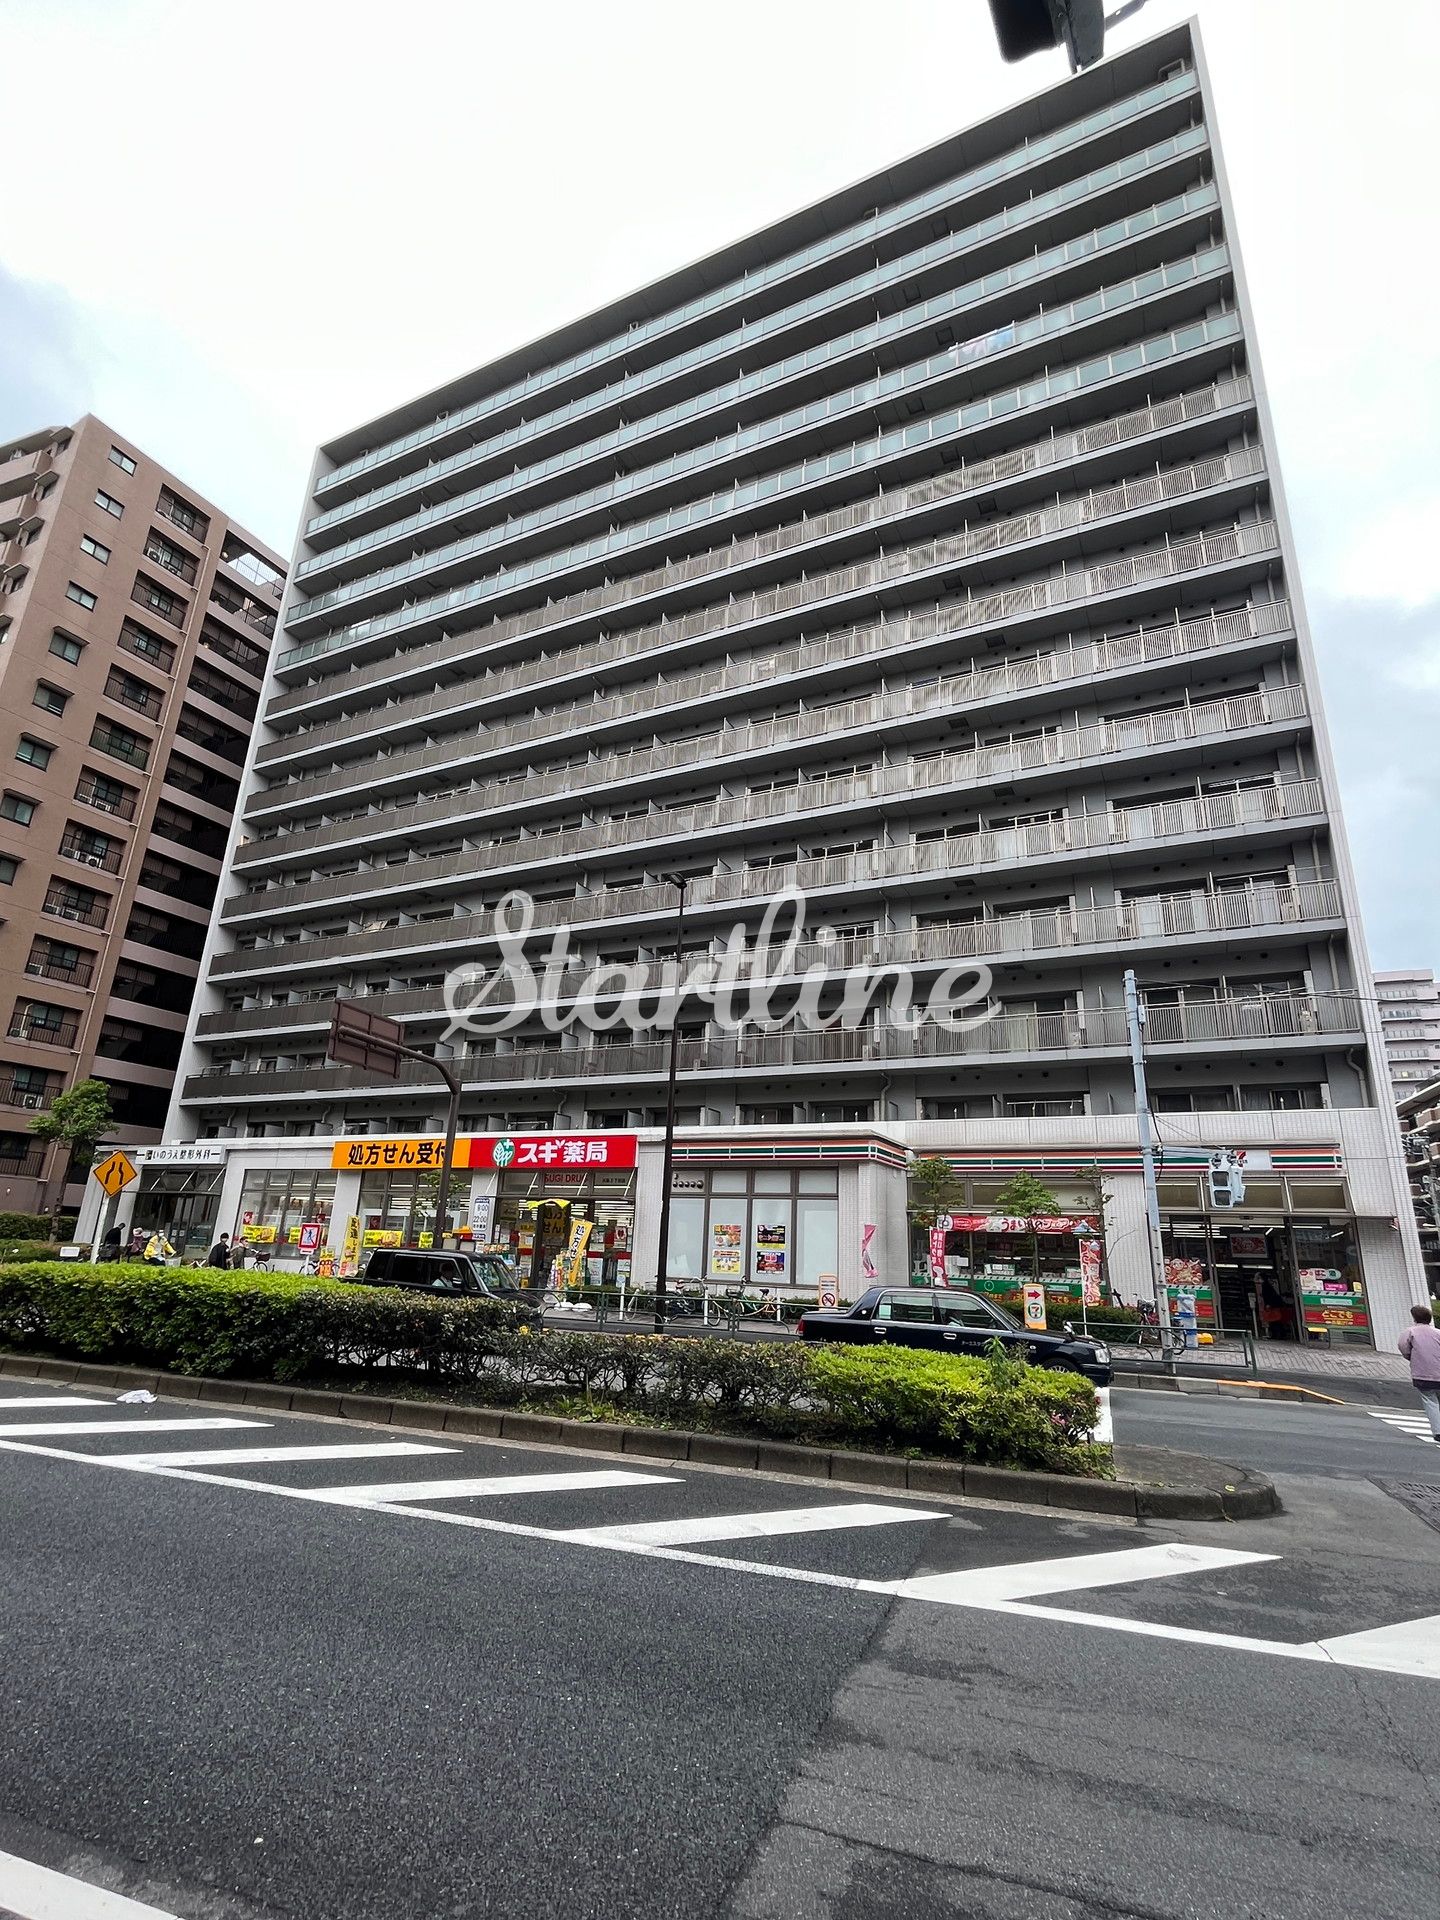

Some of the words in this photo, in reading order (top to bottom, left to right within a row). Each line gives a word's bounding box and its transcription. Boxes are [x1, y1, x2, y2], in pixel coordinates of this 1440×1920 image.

[152, 1149, 211, 1160] いのうえ整形外科
[347, 1142, 446, 1166] 処方せん受付
[517, 1139, 608, 1163] スギ薬局
